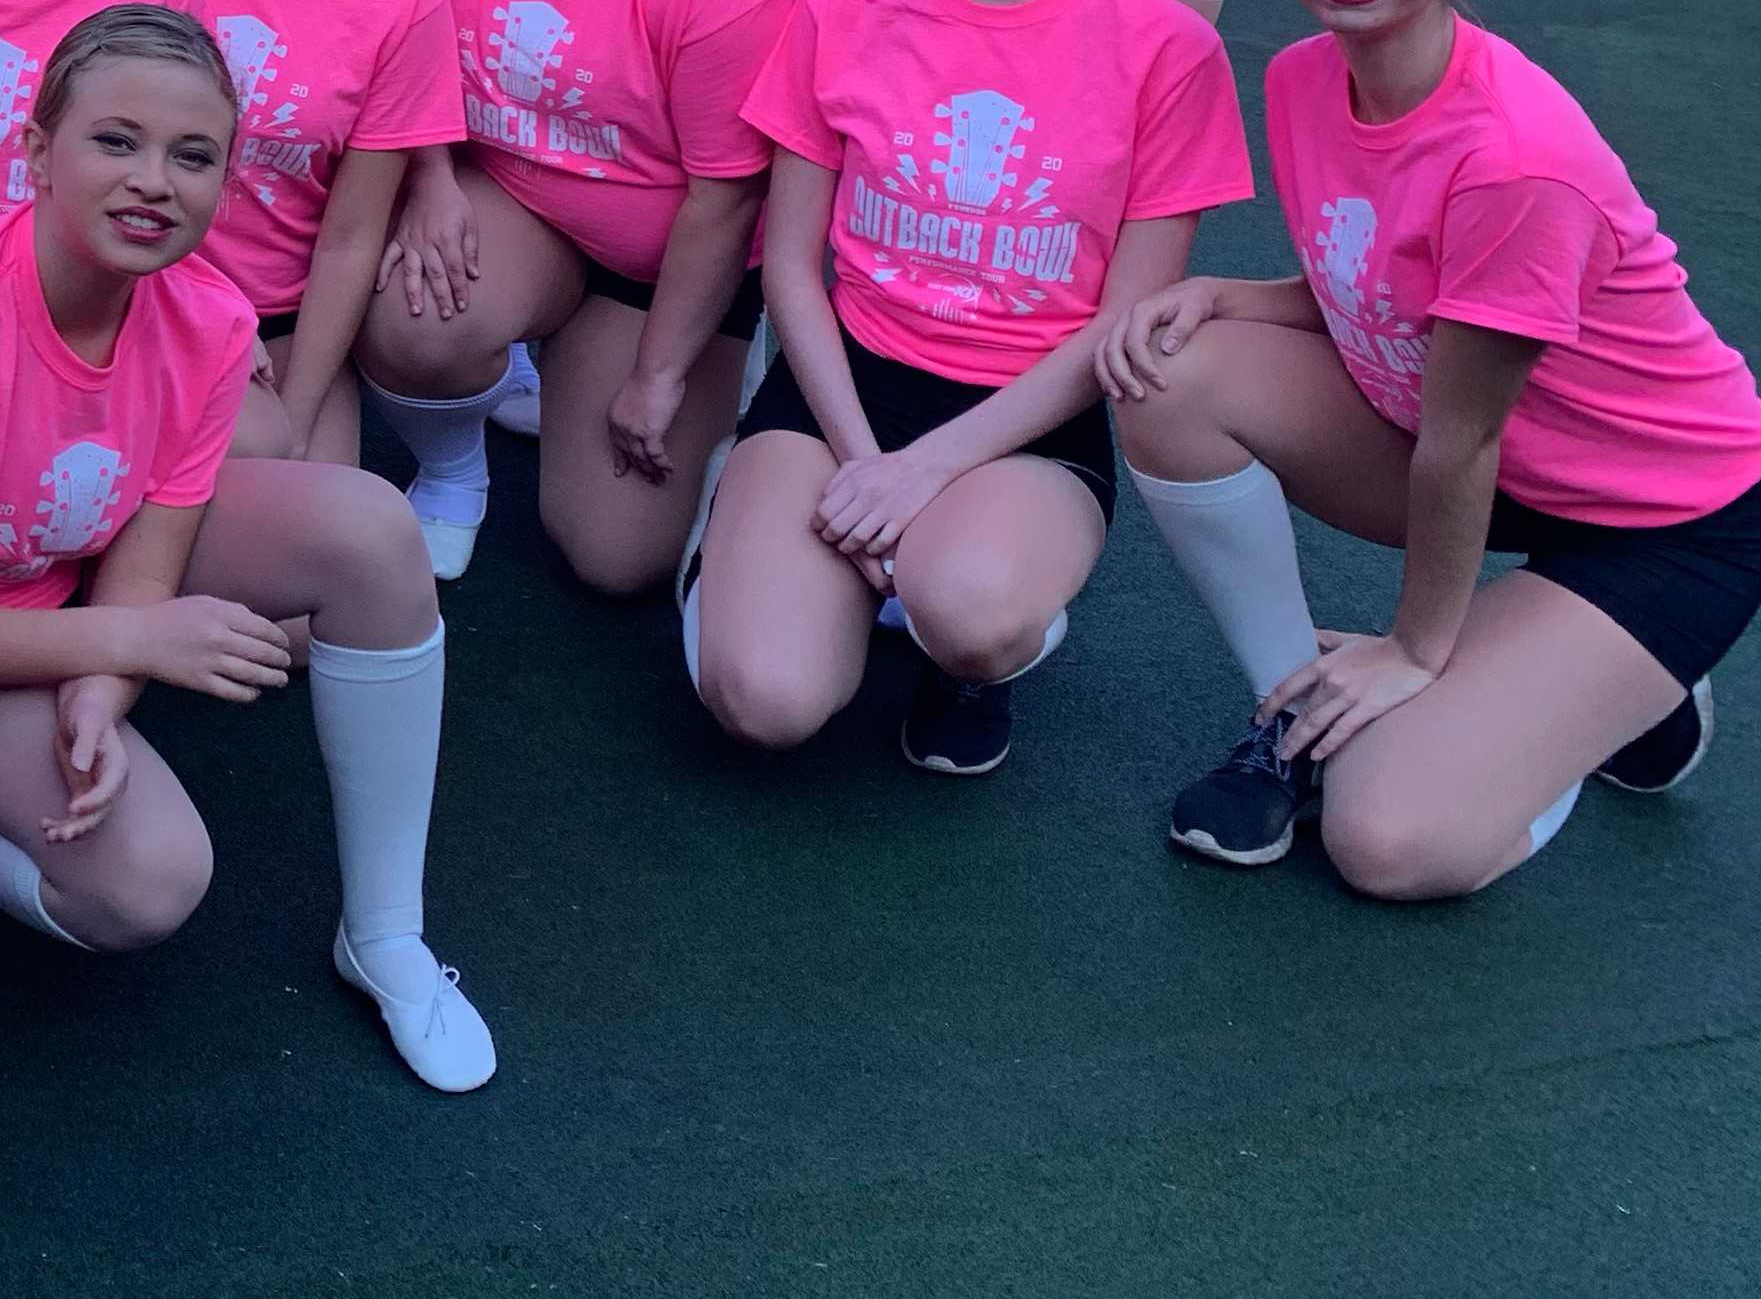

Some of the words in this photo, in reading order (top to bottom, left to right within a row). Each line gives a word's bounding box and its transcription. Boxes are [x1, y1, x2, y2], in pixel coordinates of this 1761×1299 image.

[459, 28, 475, 42] 20
[575, 67, 593, 83] 20
[290, 83, 309, 98] 20
[894, 131, 914, 147] 20
[1041, 155, 1063, 171] 20
[848, 174, 985, 265] OUTBACK
[991, 220, 1083, 284] BOWL
[909, 255, 977, 277] PERFORMANCE
[980, 270, 1006, 284] TOUR
